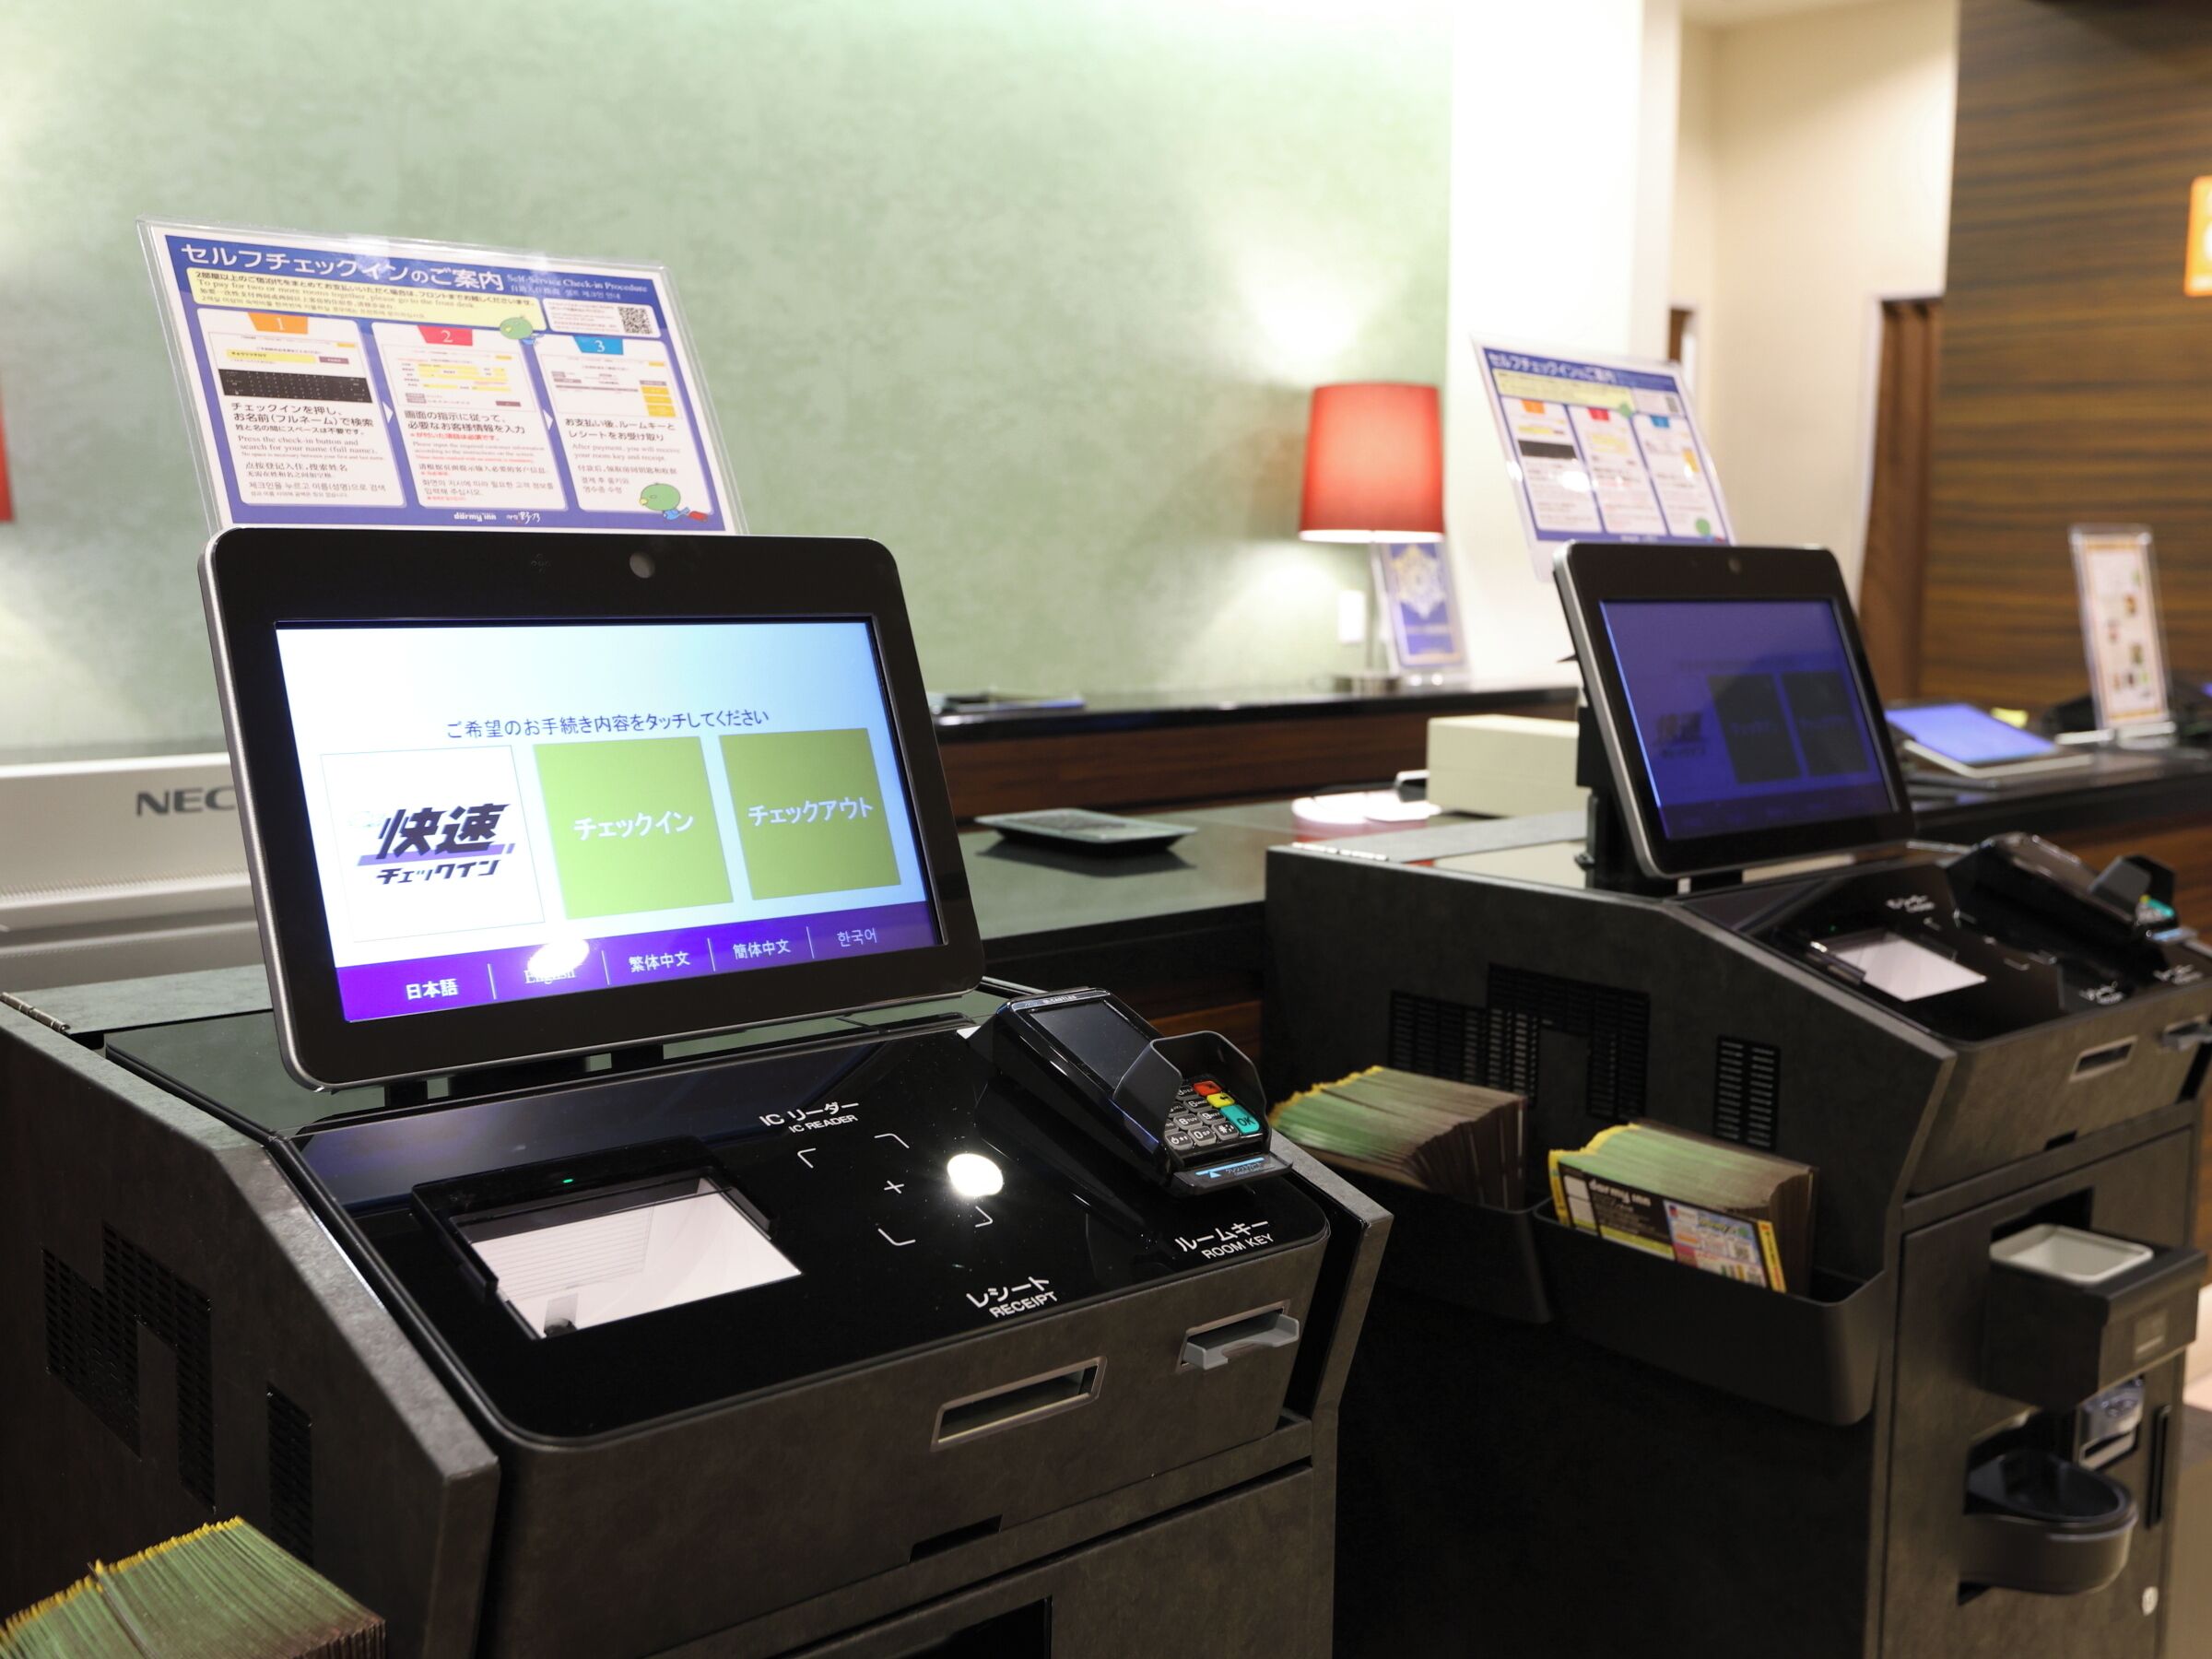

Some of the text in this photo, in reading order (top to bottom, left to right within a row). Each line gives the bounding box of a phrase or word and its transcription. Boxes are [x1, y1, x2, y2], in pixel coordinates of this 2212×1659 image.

[180, 242, 504, 291] セルフチェックインのご案内
[562, 278, 605, 289] Check-in
[604, 282, 648, 293] Procedure
[276, 317, 285, 331] 1
[441, 330, 453, 343] 2
[594, 339, 606, 353] 3
[230, 402, 343, 415] チェックインを押し、
[404, 410, 506, 423] 画面の指示に従って、
[406, 420, 525, 433] 必要なお客様情報を入力
[567, 429, 665, 441] レシートをお受け取り
[446, 708, 770, 738] ご希望のお手続き内容をタッチしてください
[135, 786, 236, 818] NEC
[747, 795, 873, 827] チェックアウト
[376, 803, 511, 859] 快速
[572, 810, 694, 841] チェックイン
[376, 860, 500, 885] チェックイン
[837, 927, 877, 947] 한국어
[732, 938, 792, 959] 簡体中文
[628, 950, 691, 973] 繁体中文
[406, 978, 459, 1000] 日本語
[759, 1101, 859, 1126] IC リーダー
[788, 1114, 859, 1134] IC READER
[1237, 1116, 1256, 1127] OK
[1175, 1221, 1269, 1252] ルームキー
[1201, 1233, 1275, 1260] ROOM KEY
[966, 1277, 1050, 1309] レシート
[989, 1290, 1058, 1319] RECEIPT
